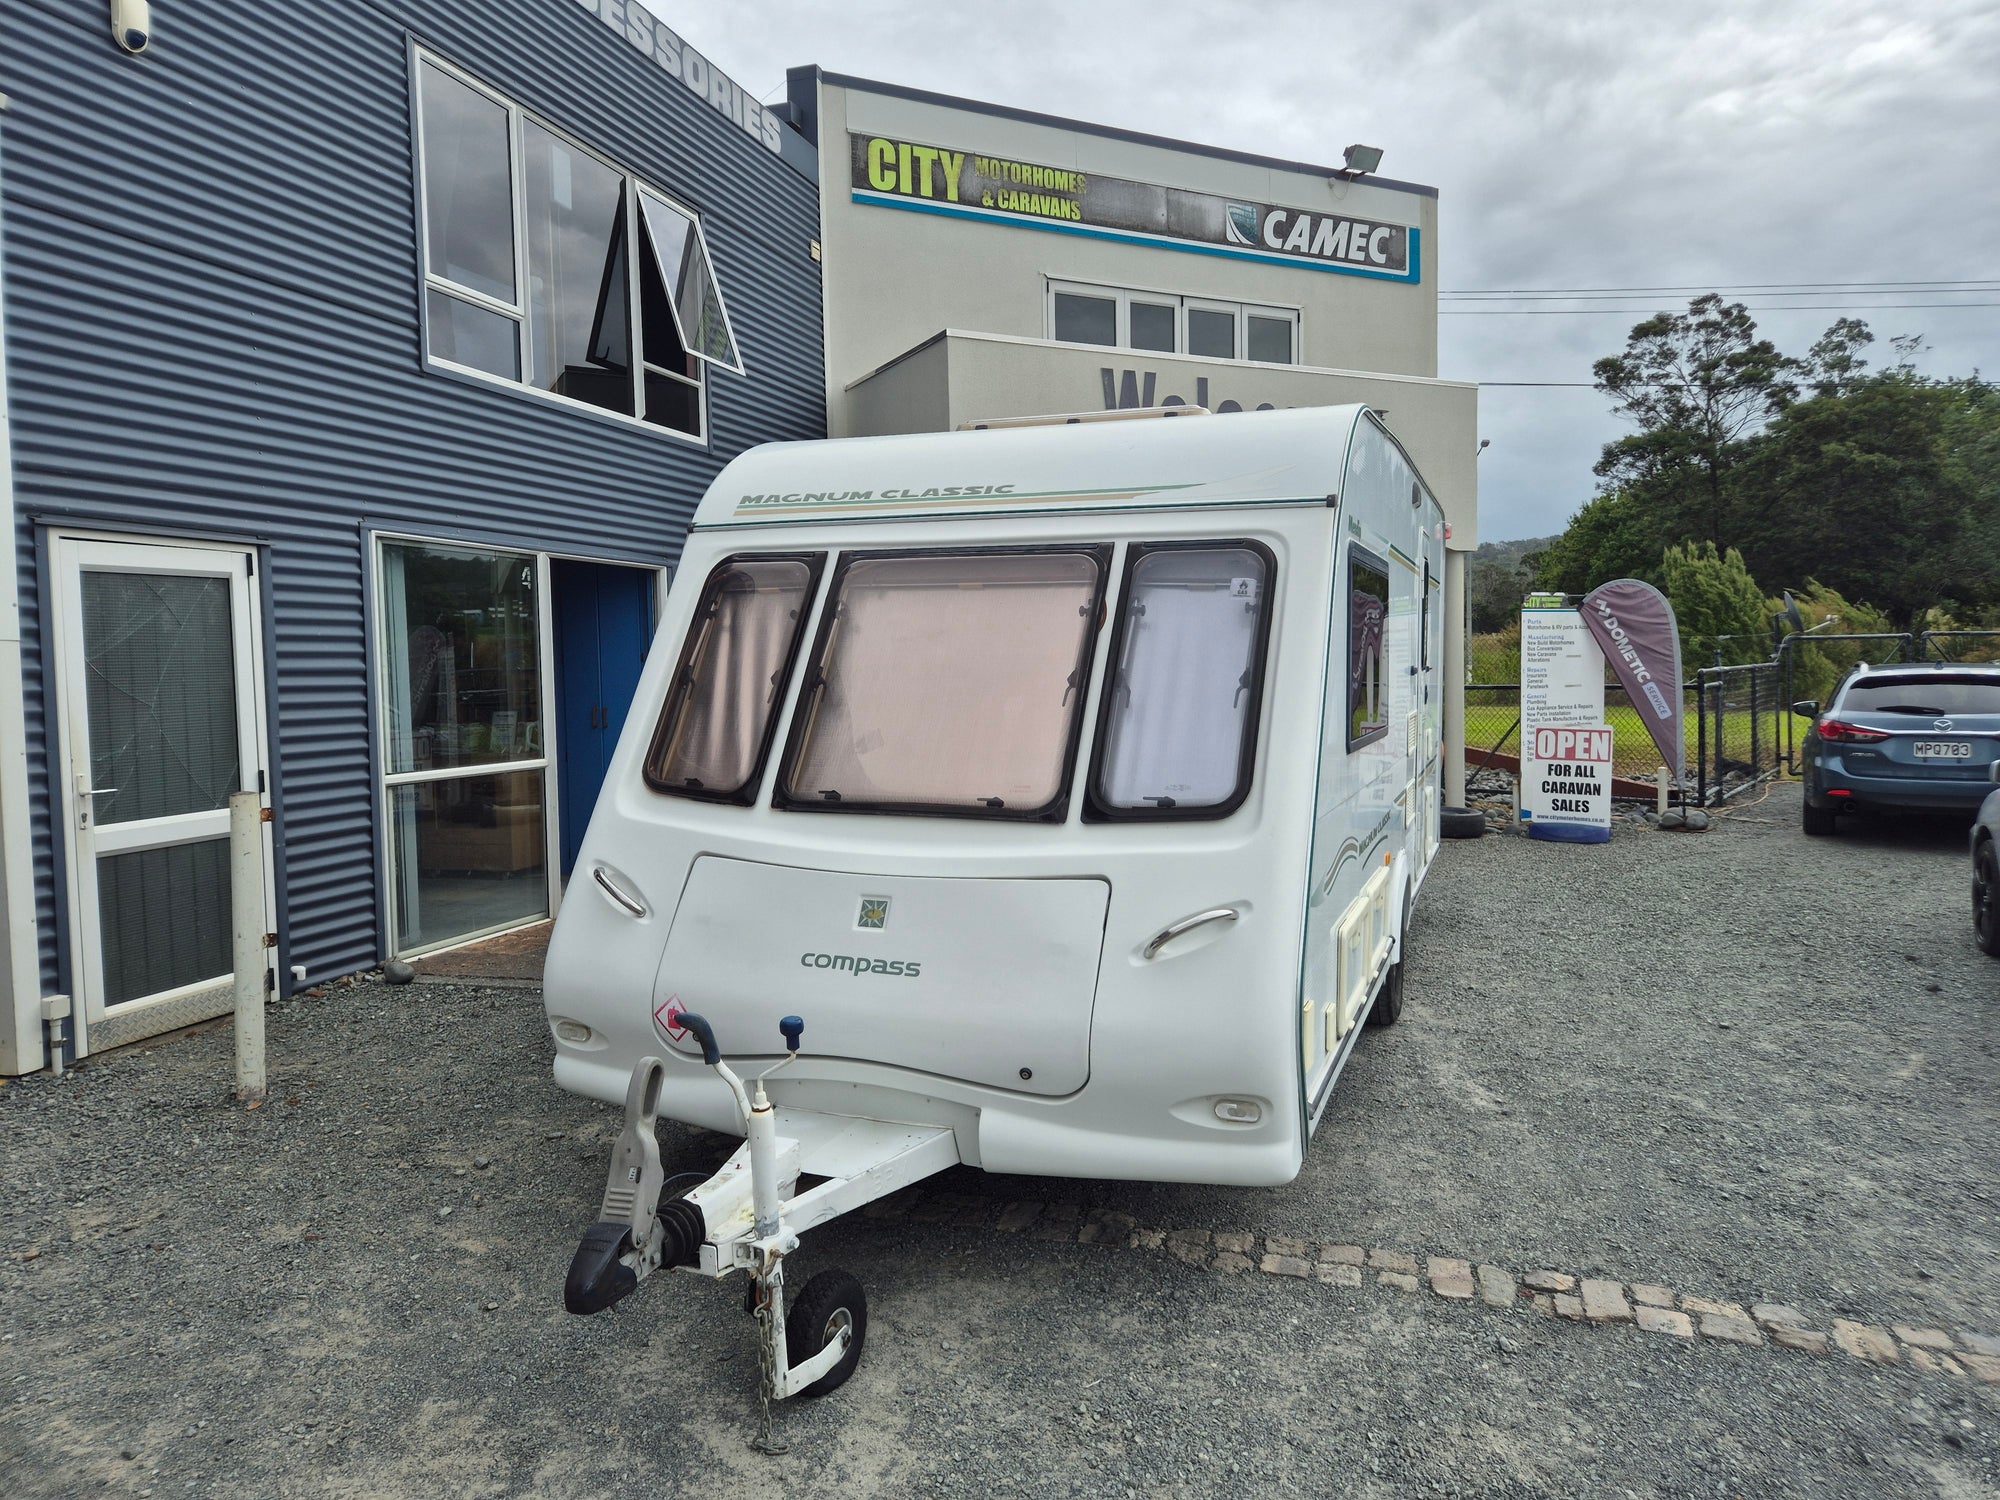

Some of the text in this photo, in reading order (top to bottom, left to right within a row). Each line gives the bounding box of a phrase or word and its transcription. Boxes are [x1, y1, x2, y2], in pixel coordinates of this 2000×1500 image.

[867, 138, 965, 202] CITY
[974, 156, 1087, 194] MOTORHOMES
[982, 188, 1082, 221] & CARAVANS
[1263, 210, 1392, 264] CAMEC
[739, 484, 1016, 505] MAGNUM CLASSIC
[1603, 617, 1651, 683] DOMETIC
[1647, 685, 1668, 716] SERVICE
[1537, 729, 1610, 760] OPEN
[1548, 764, 1595, 778] FOR ALL
[1542, 780, 1601, 796] CARAVAN
[1552, 799, 1590, 813] SALES
[801, 952, 921, 977] compass
